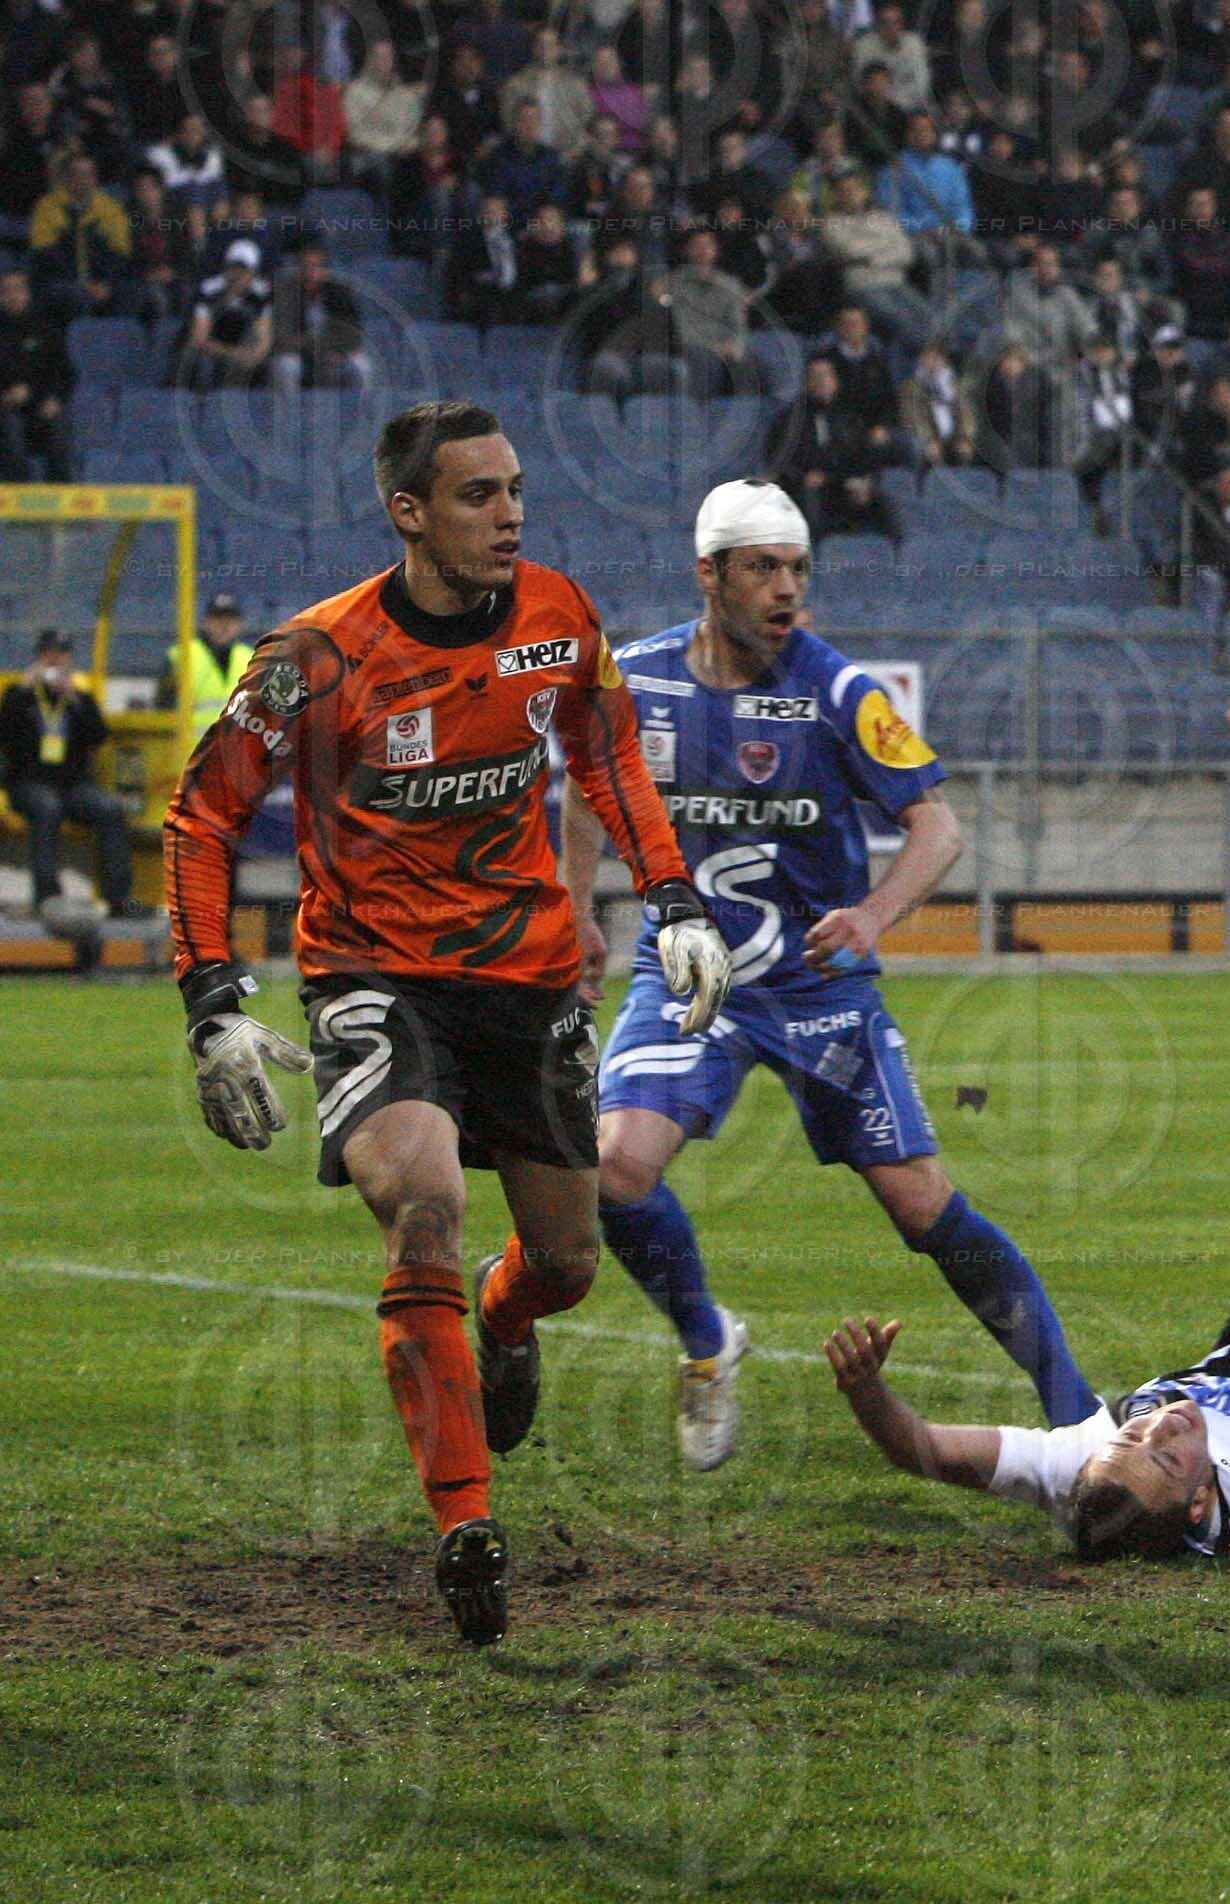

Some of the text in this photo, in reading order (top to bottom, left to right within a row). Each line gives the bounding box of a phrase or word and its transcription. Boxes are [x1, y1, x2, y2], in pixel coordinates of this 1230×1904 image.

[389, 748, 429, 764] LIGA
[666, 795, 820, 826] PERFUND
[784, 1010, 862, 1040] FUCHS
[858, 1106, 892, 1129] 22
